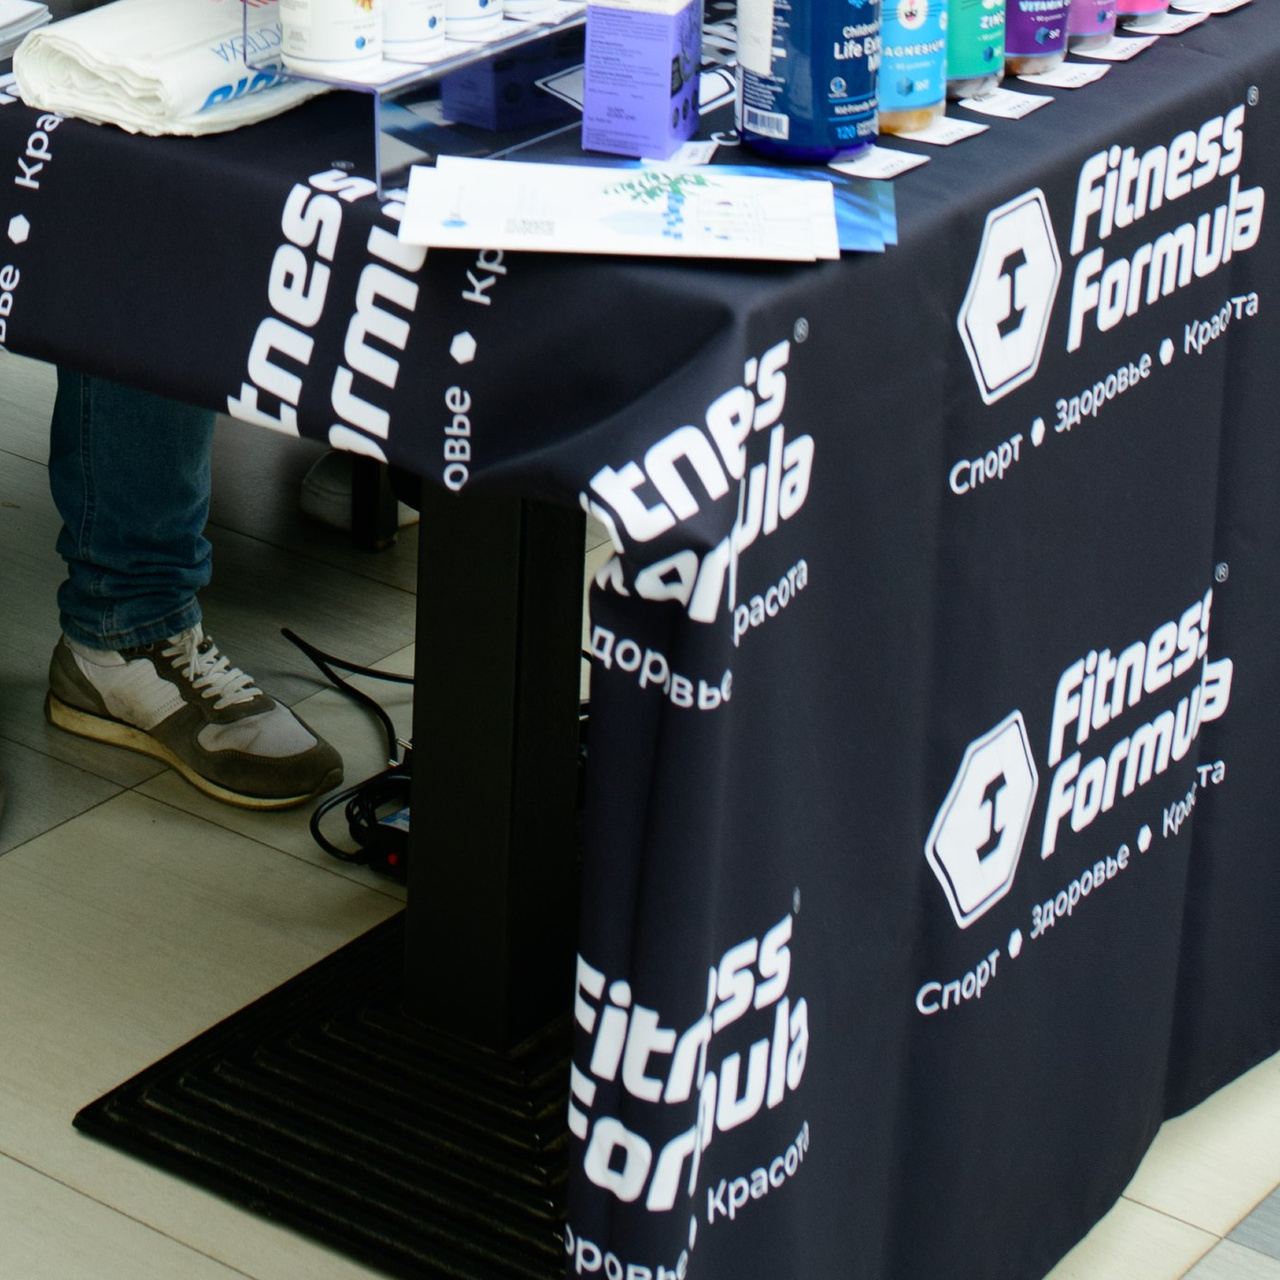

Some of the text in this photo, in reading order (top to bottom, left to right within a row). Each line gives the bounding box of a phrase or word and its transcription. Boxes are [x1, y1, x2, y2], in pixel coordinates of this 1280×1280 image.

[834, 42, 863, 60] Life
[835, 123, 856, 139] 120
[1069, 104, 1245, 256] Fitness
[1066, 174, 1265, 353] Formula
[948, 433, 1024, 495] Спорт
[1054, 352, 1152, 435] Здоровье
[1040, 653, 1233, 861] Formua
[915, 759, 1226, 1016] Спорт Здоровье Крата
